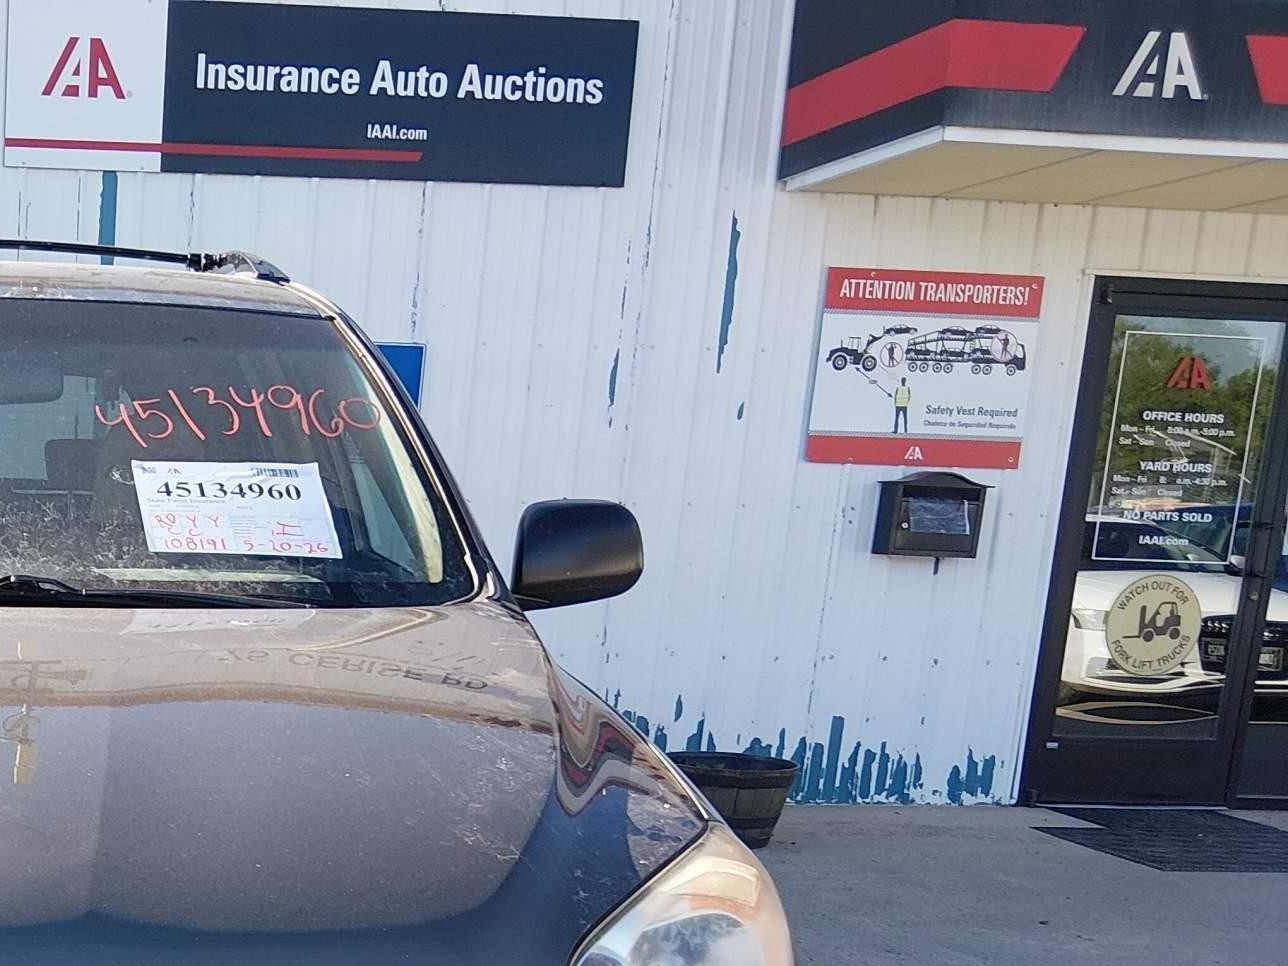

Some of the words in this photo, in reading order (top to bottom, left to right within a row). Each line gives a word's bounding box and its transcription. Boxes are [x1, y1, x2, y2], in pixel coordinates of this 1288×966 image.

[196, 52, 360, 95] Insurance
[370, 60, 447, 98] Auto
[456, 63, 604, 105] Auctions
[366, 123, 428, 141] IAAI.com
[839, 278, 915, 300] ATTENTION
[919, 281, 1030, 306] TRANSPORTERS!
[94, 384, 382, 448] 45134960
[925, 404, 953, 417] Safety
[956, 405, 975, 416] Vest
[977, 406, 1018, 420] Required
[1142, 410, 1183, 422] OFFICE
[1184, 412, 1225, 424] HOURS
[1120, 424, 1138, 433] Mon
[1119, 437, 1132, 445] Sat
[1139, 437, 1155, 446] Sun
[1139, 460, 1171, 472] YARD
[1172, 462, 1213, 474] HOURS
[1112, 474, 1130, 482] Mon
[1137, 475, 1148, 483] Fri
[156, 480, 302, 502] 45134960
[1123, 510, 1141, 521] NO
[1143, 511, 1180, 522] PARTS
[1181, 512, 1212, 523] SOLD
[164, 536, 227, 550] 108191
[1138, 534, 1189, 546] IAAI.com
[1117, 582, 1149, 611] WATCH
[1152, 580, 1173, 592] OUT
[1170, 586, 1190, 605] FOR
[1112, 639, 1132, 664] FORK
[1132, 658, 1154, 669] LIFT
[1155, 635, 1191, 667] TRUCKS
